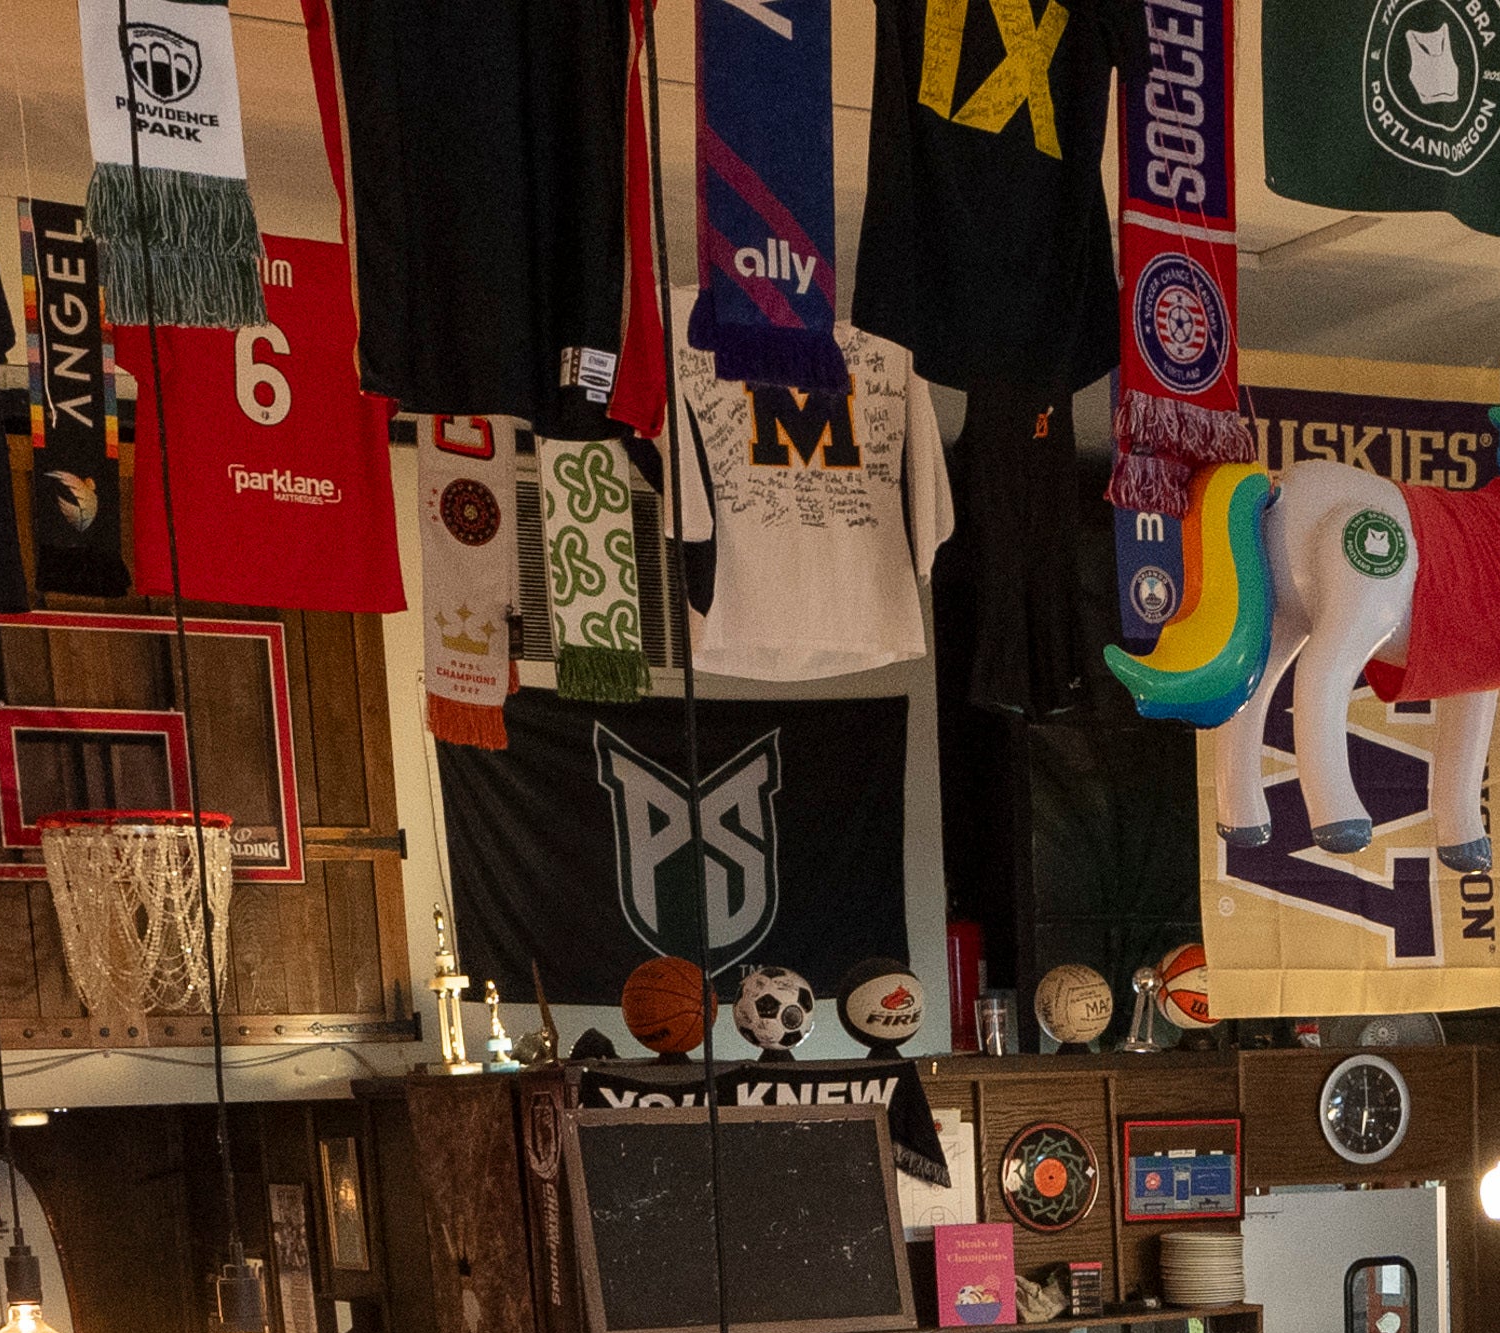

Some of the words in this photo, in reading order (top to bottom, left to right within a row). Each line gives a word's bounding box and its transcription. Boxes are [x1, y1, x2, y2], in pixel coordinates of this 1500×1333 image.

[115, 95, 220, 128] POVIDENCE
[1371, 80, 1451, 160] PORTLAND
[1452, 98, 1496, 162] OREGON
[137, 118, 203, 143] PARK
[734, 238, 817, 294] ally
[234, 322, 292, 426] 6
[233, 468, 335, 497] parklane
[868, 1012, 923, 1027] FIRE
[946, 1252, 1008, 1264] Champions
[955, 1238, 986, 1249] Meals
